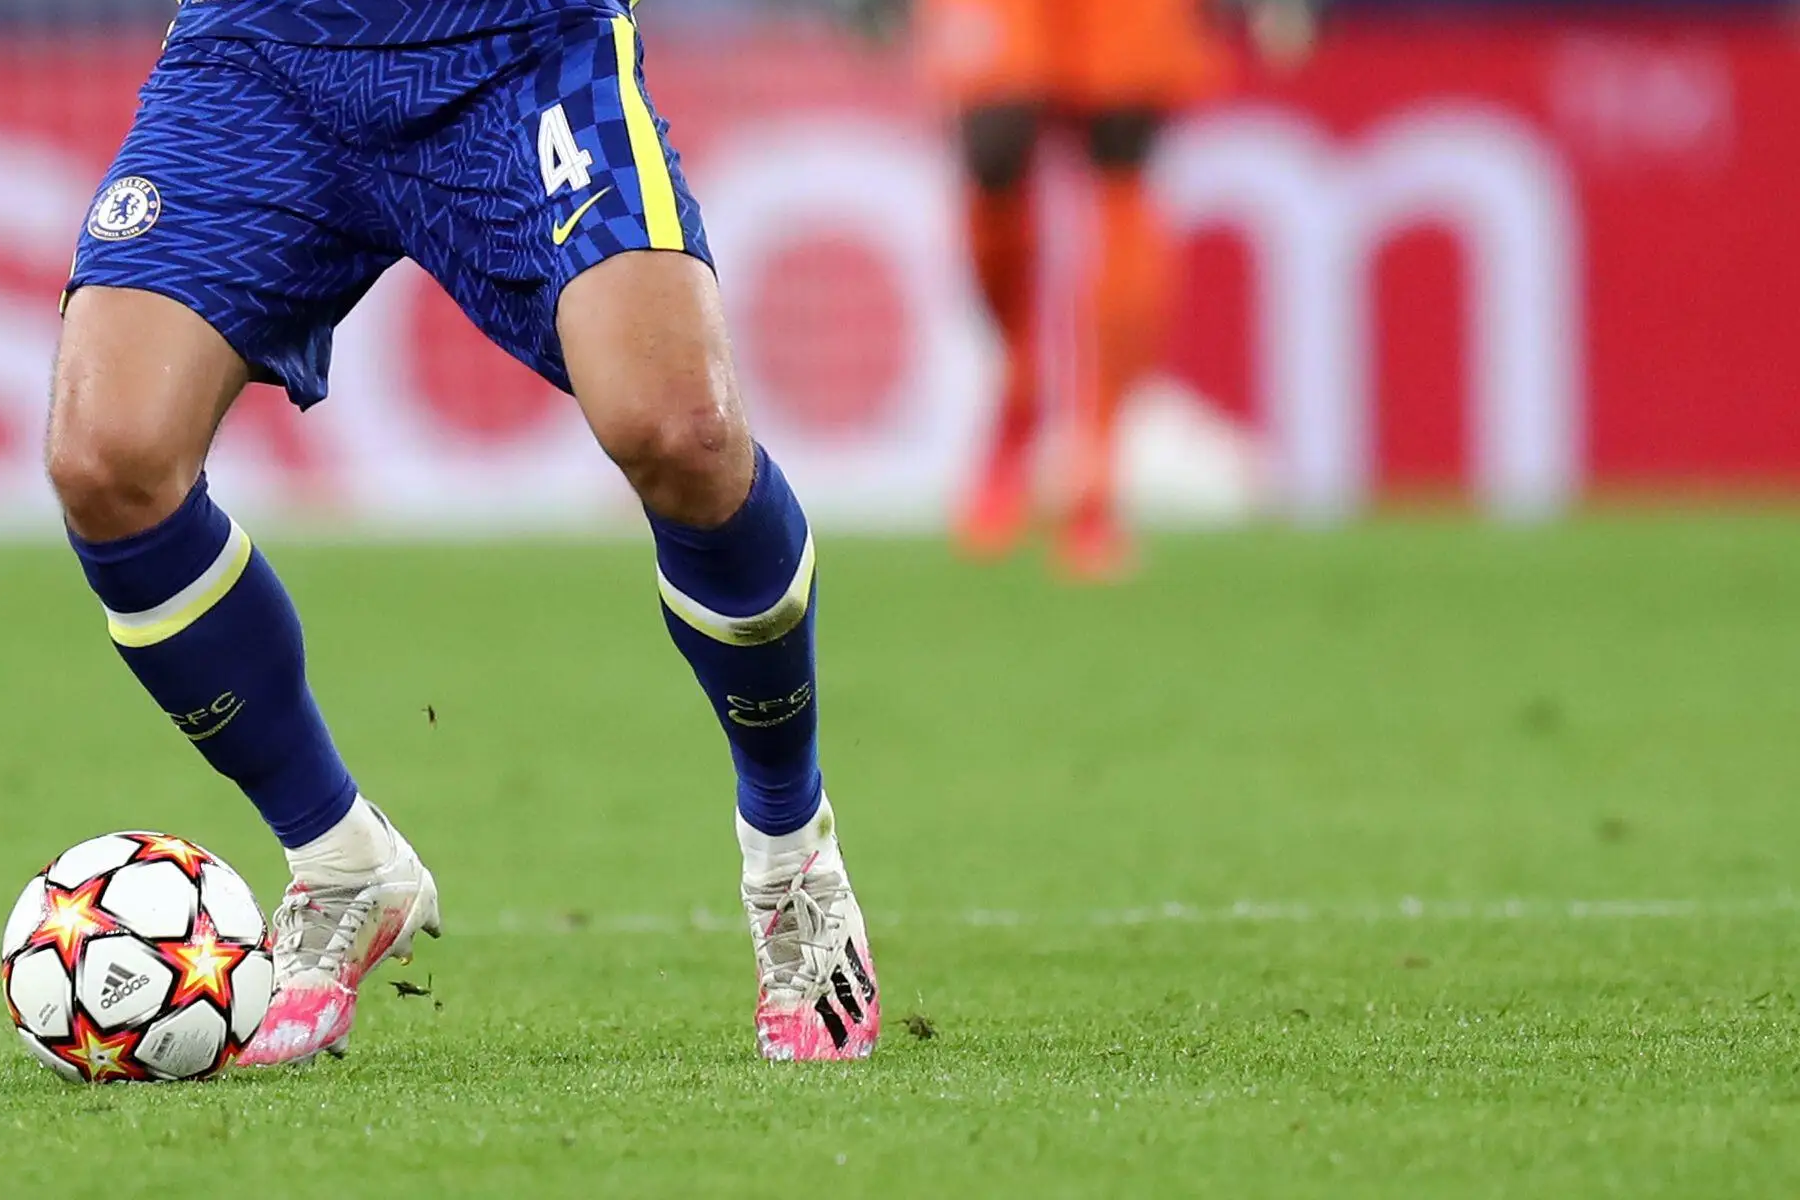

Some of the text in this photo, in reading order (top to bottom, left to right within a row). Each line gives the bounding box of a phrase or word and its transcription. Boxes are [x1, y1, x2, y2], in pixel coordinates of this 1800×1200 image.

[537, 103, 593, 197] 4
[726, 680, 810, 713] CFC
[100, 974, 151, 1010] adidas
